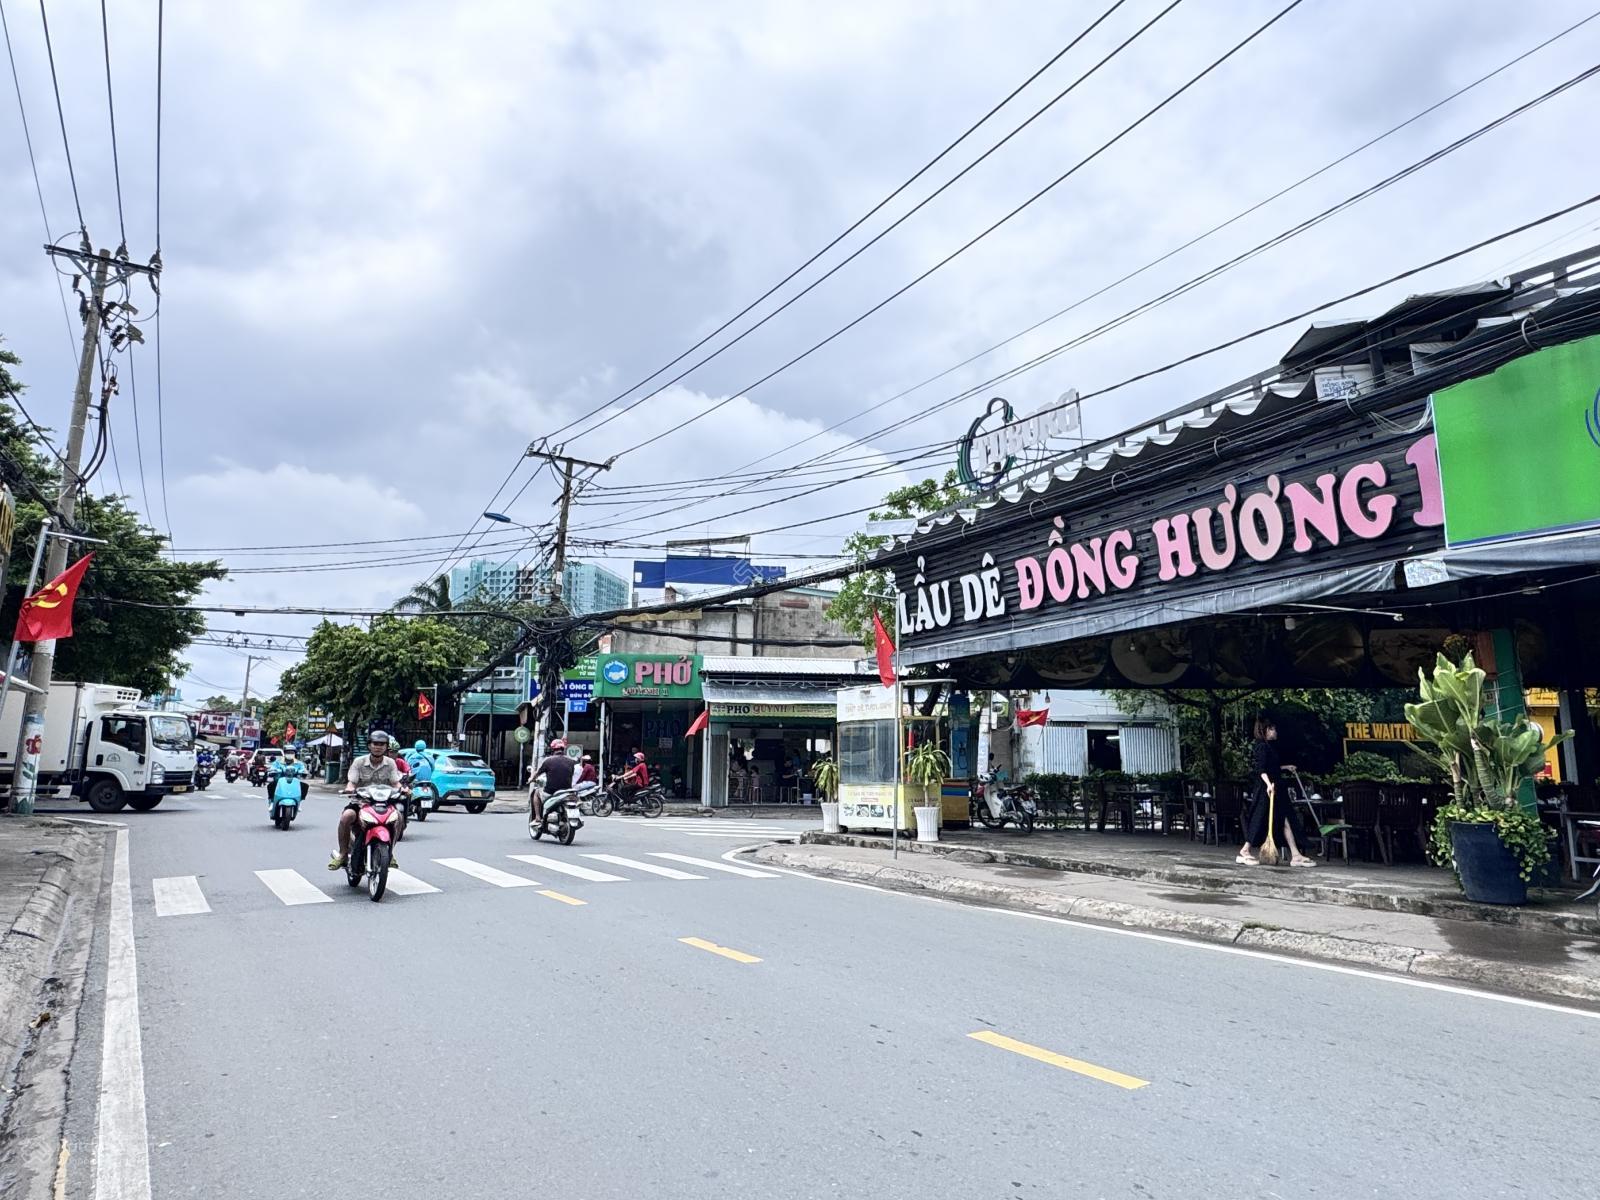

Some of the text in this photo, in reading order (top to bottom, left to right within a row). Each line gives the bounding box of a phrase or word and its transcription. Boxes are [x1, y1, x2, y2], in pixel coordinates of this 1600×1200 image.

[900, 555, 951, 635] LẨU
[960, 552, 1006, 622] DÊ
[1015, 515, 1140, 610] ĐỒNG
[1152, 460, 1398, 581] HƯƠNG
[635, 655, 692, 685] PHỞ
[569, 682, 587, 690] ÔNG
[1345, 722, 1371, 738] THE
